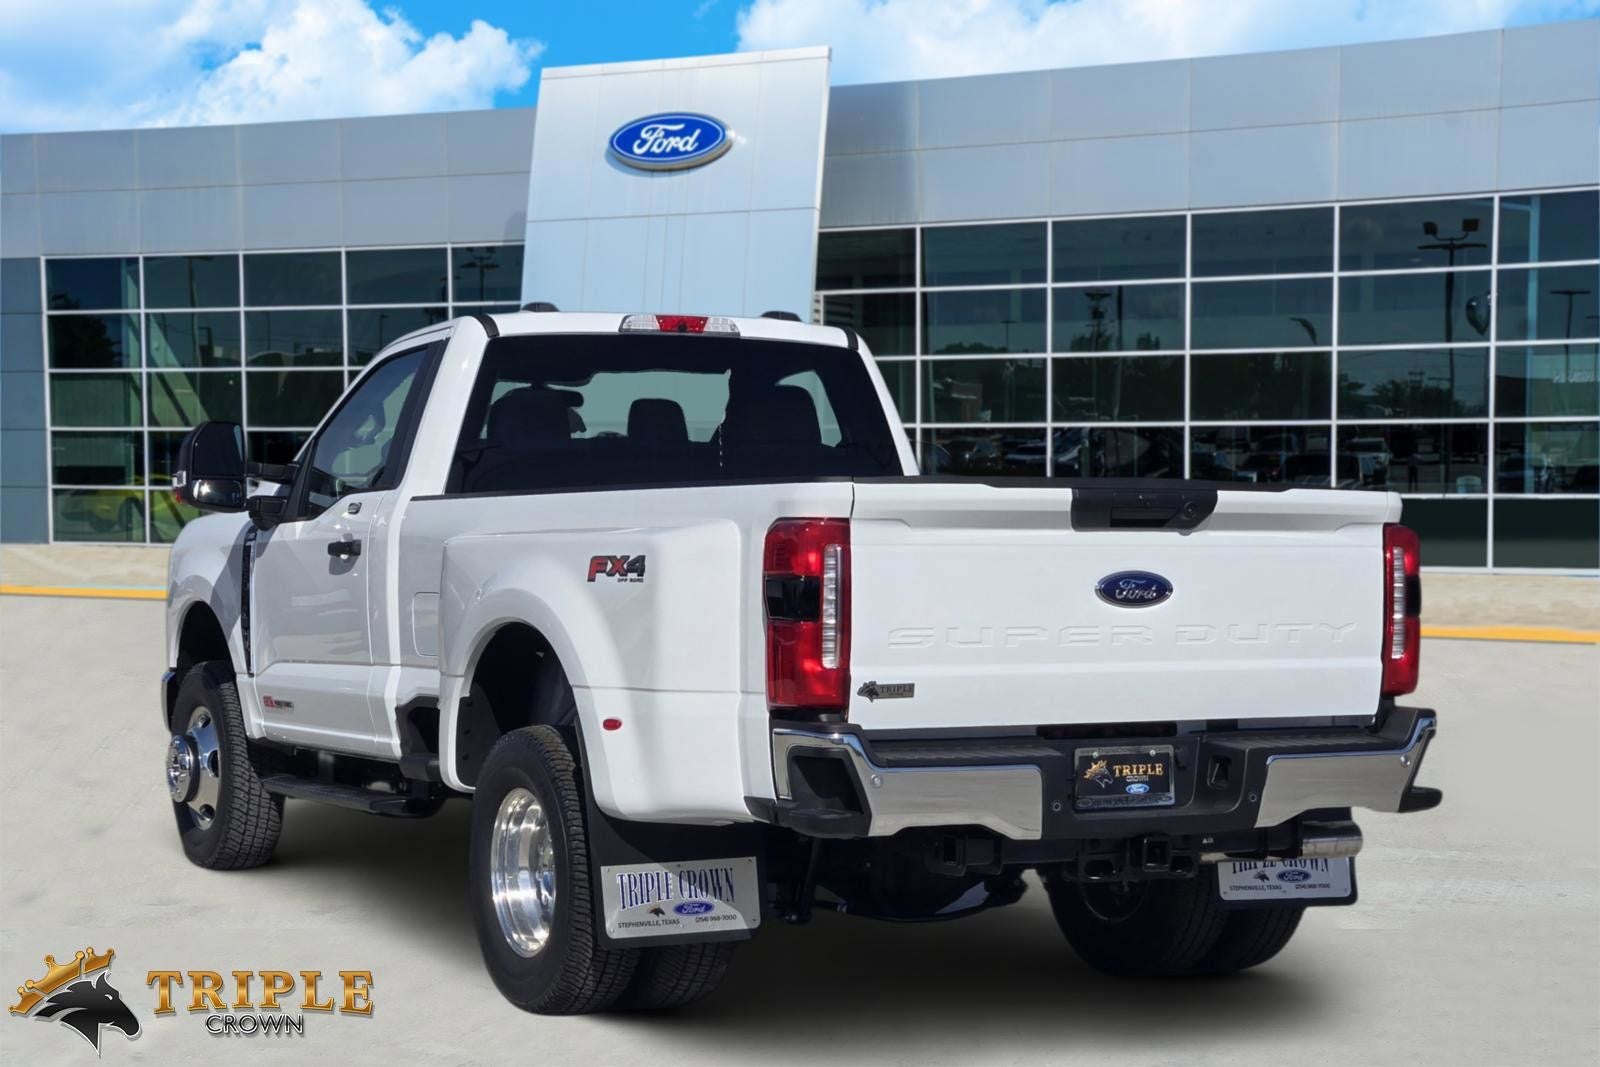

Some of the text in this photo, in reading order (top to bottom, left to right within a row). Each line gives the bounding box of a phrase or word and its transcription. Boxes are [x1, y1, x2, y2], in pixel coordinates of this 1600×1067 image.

[632, 123, 701, 155] Ford
[587, 555, 646, 582] FX4
[1115, 579, 1157, 599] Ford
[888, 622, 1357, 648] SUPER DUTY
[880, 685, 913, 693] TRIPLE
[1113, 763, 1163, 777] TRIPLE
[618, 868, 735, 910] TRIPLE CROWN
[681, 902, 706, 914] Ford
[617, 918, 680, 929] STEPHENVILLE, TEXAS
